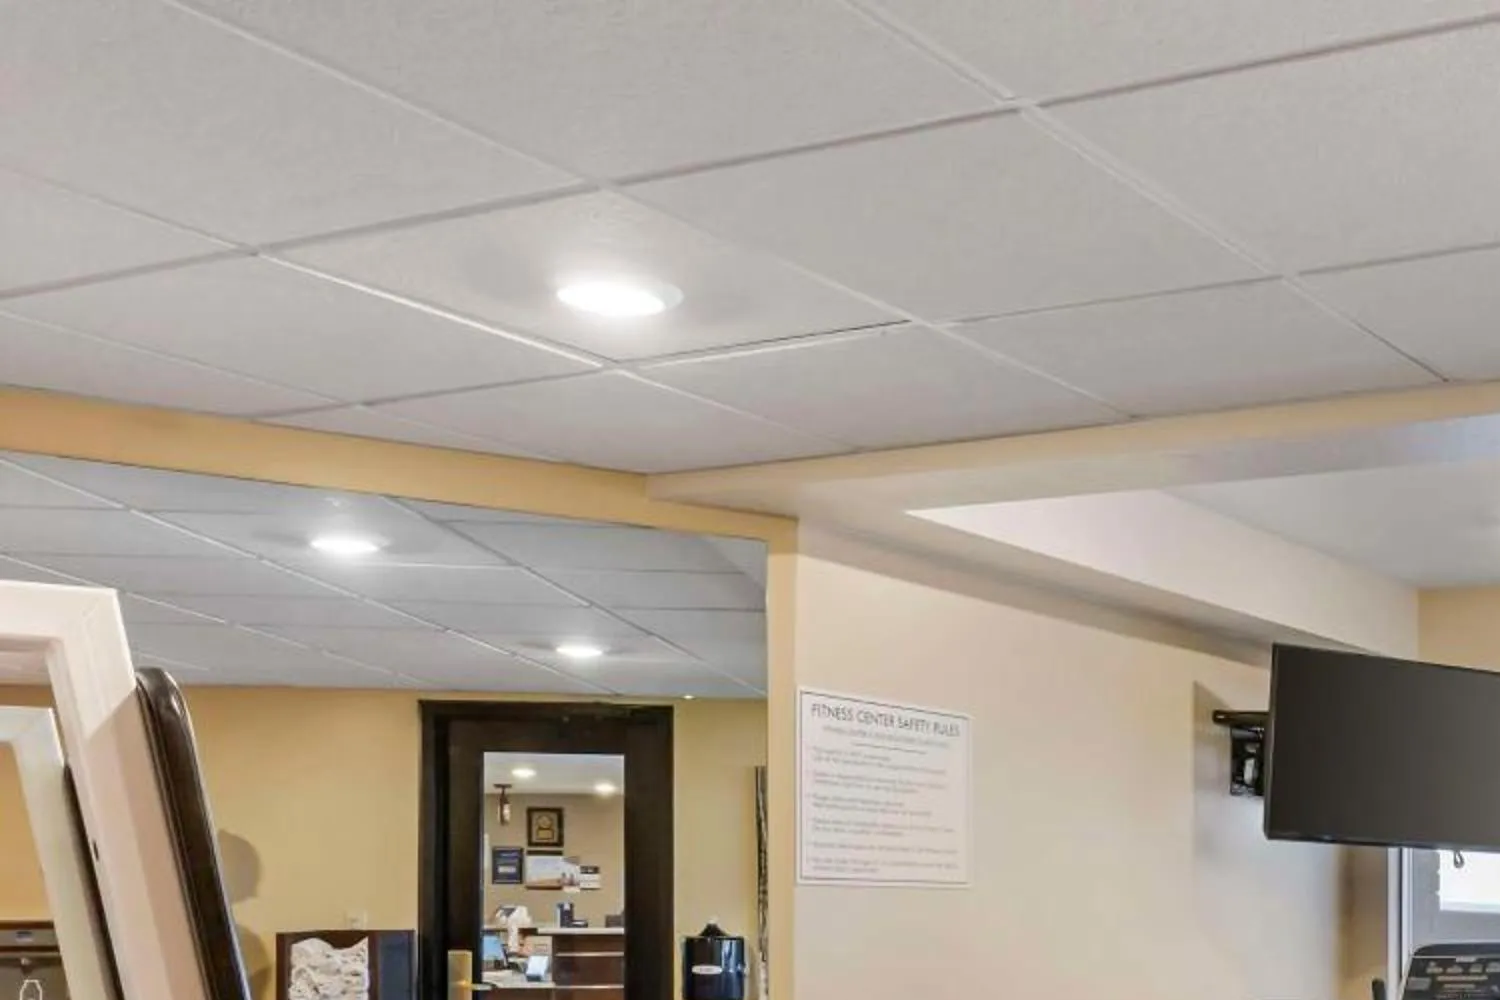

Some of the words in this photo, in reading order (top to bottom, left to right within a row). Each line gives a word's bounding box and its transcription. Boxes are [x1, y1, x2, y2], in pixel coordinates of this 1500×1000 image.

[811, 703, 854, 721] FITNESS
[857, 710, 894, 728] CENTER
[898, 716, 930, 733] SAFETY
[933, 721, 960, 737] RULES
